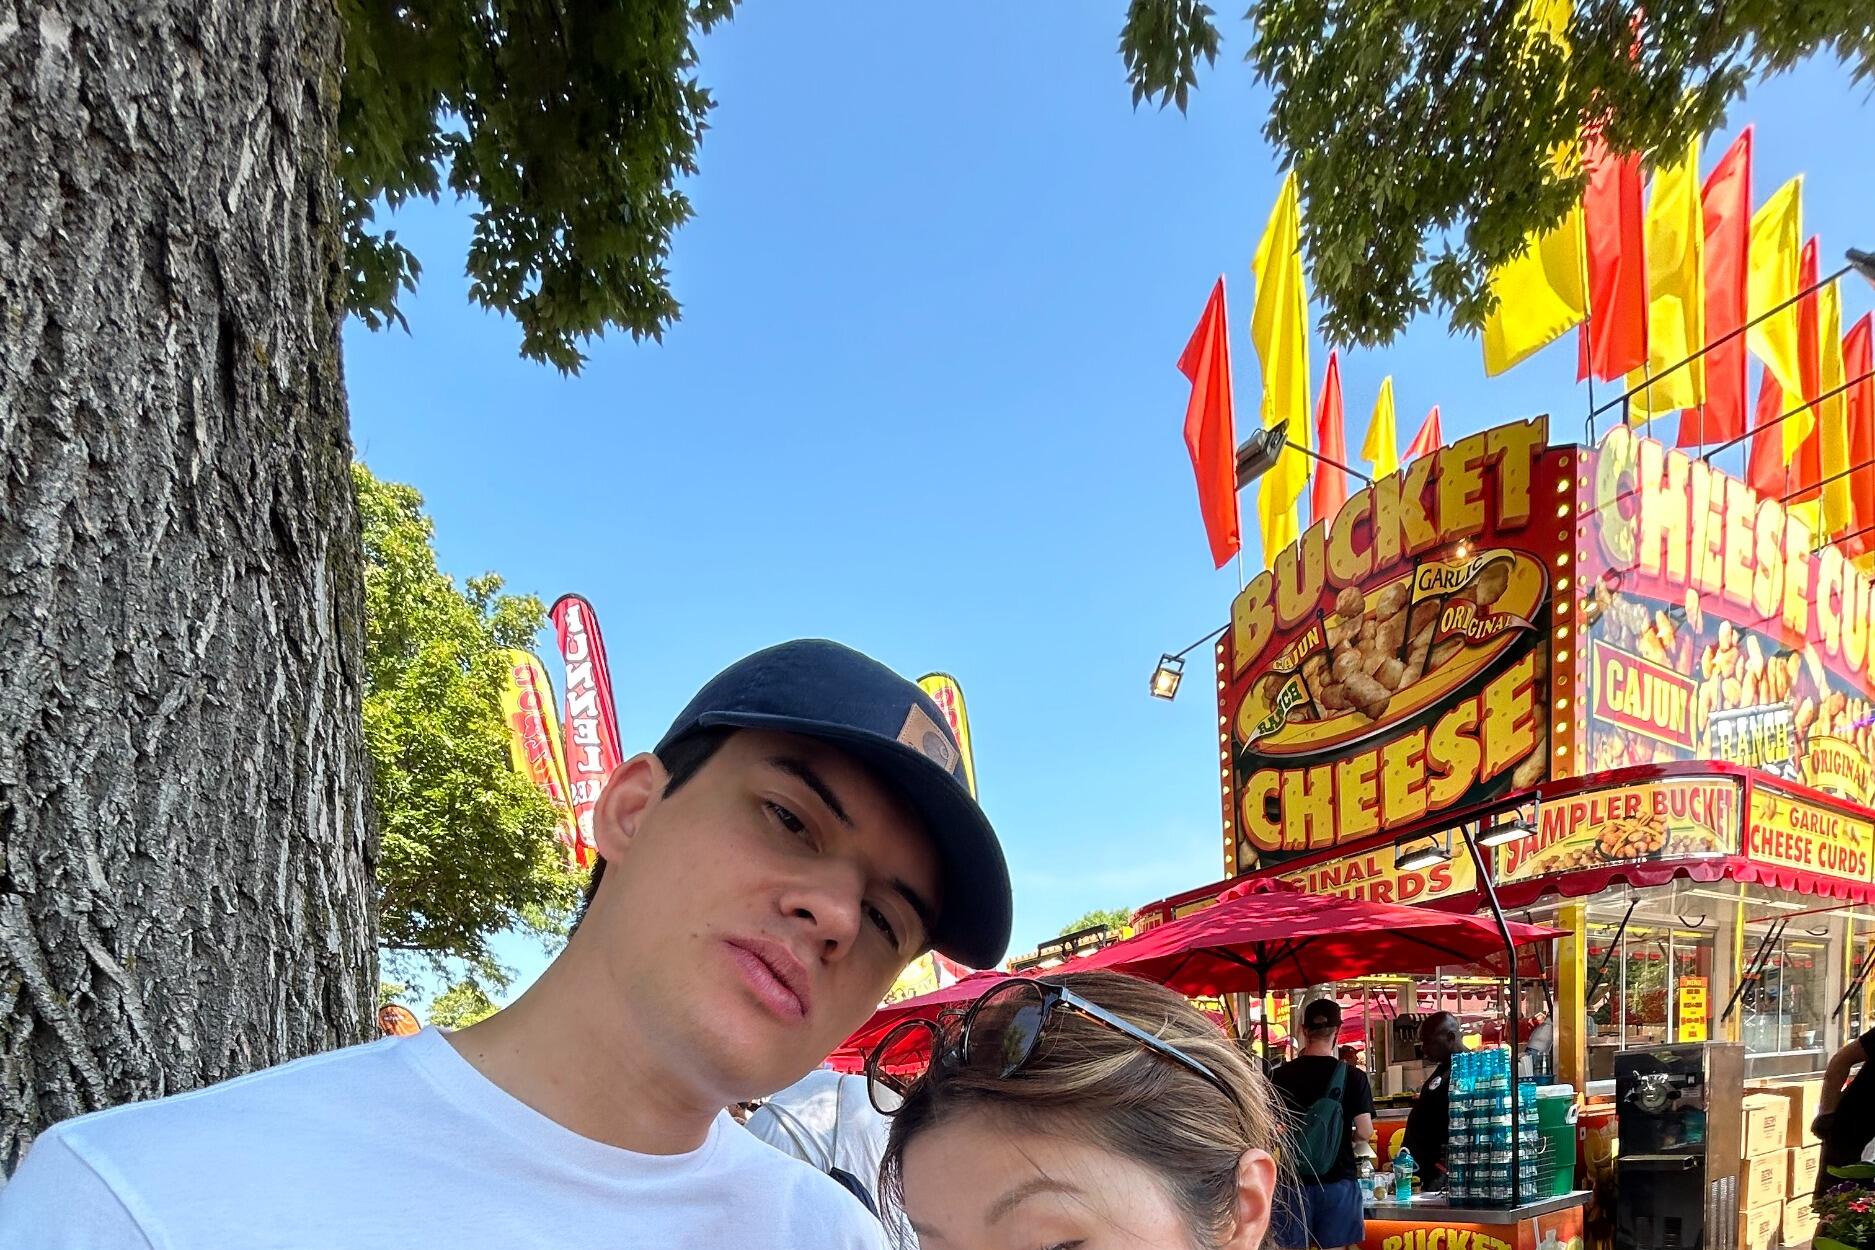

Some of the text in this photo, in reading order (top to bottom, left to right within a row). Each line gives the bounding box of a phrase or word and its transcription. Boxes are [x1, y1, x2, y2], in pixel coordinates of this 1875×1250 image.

[1231, 414, 1548, 682] BUCKET
[1419, 552, 1483, 592] GARLIC
[1595, 423, 1875, 690] CHEESE CU
[1441, 605, 1512, 639] ORIGINAL
[1273, 627, 1319, 671] CAJUN
[1258, 680, 1304, 735] RANCH
[1606, 660, 1688, 734] CAJUN
[1242, 651, 1535, 851] CHEESE
[1718, 710, 1789, 767] RANCH
[1811, 749, 1867, 793] ORIGINAL
[1506, 785, 1733, 876] SAMPLER BUCKET
[1789, 807, 1839, 839] GARLIC
[1751, 828, 1867, 877] CHEESE CURDS
[1340, 863, 1453, 904] URDS
